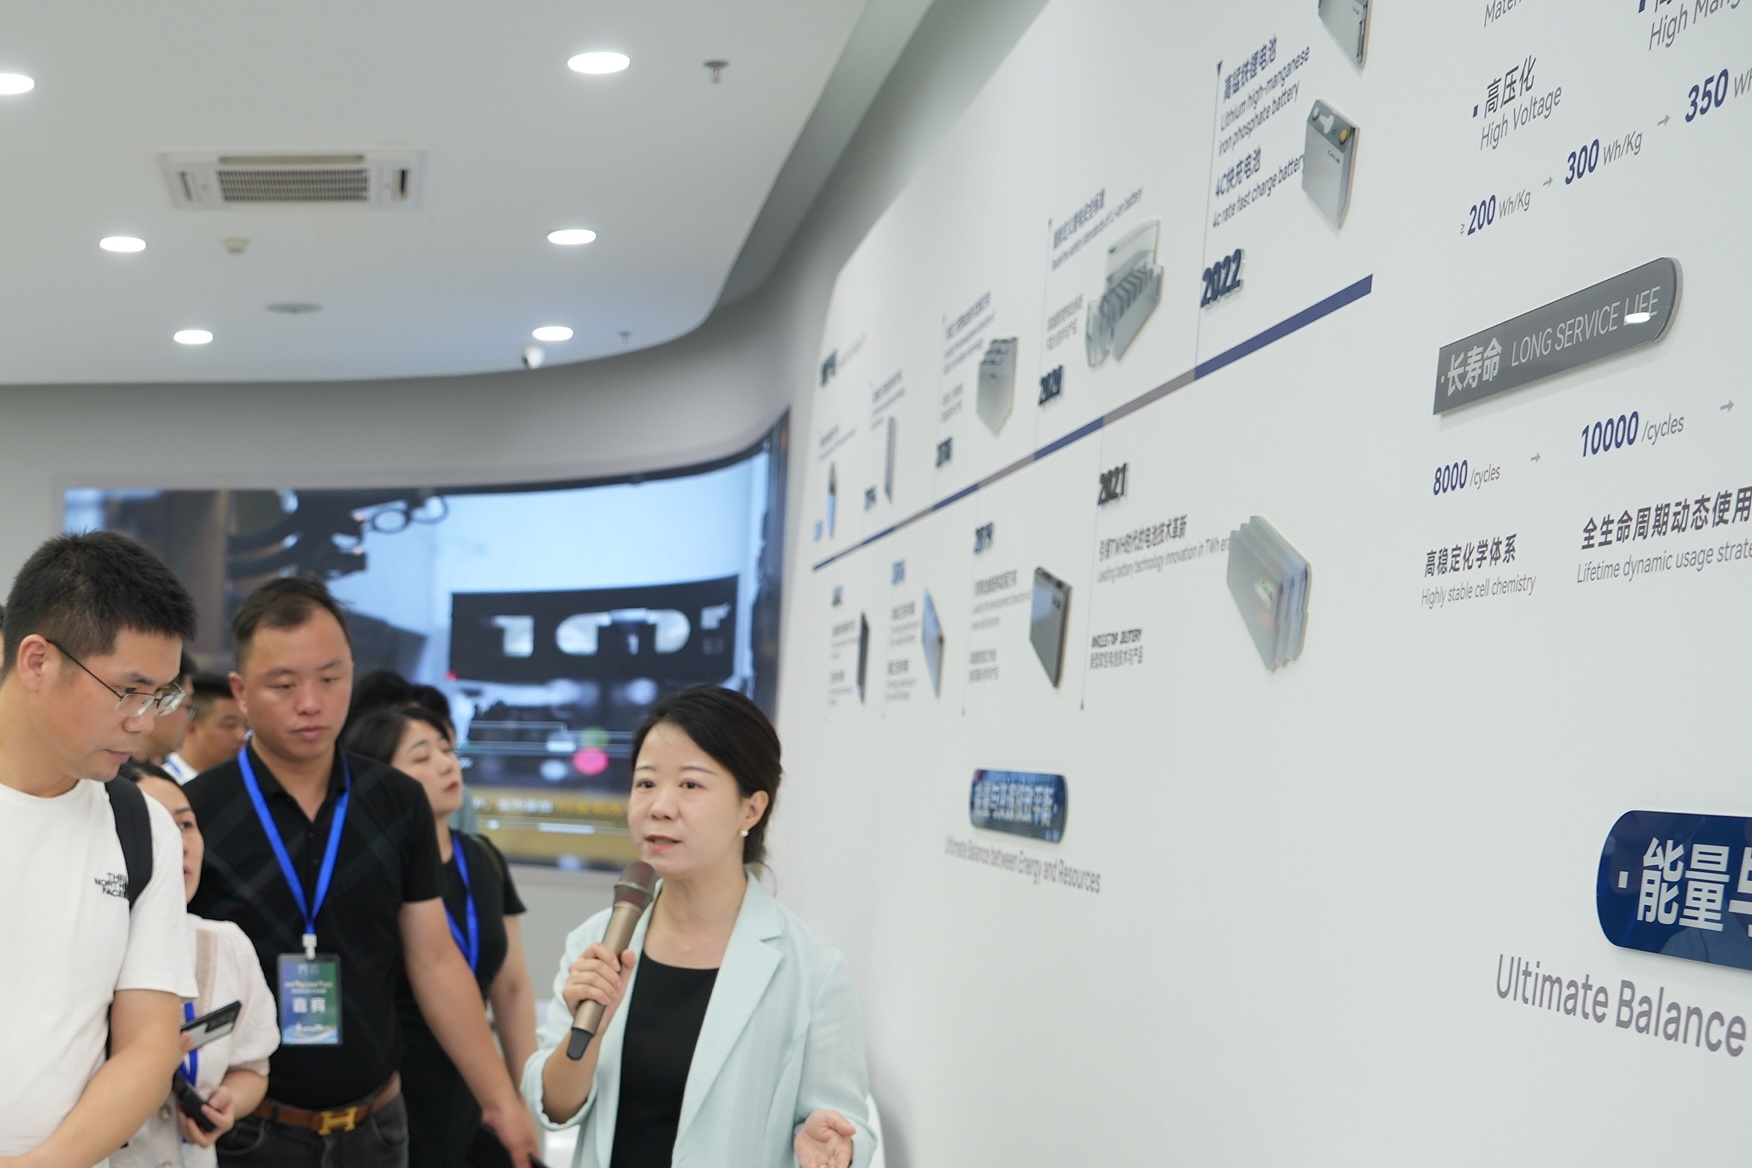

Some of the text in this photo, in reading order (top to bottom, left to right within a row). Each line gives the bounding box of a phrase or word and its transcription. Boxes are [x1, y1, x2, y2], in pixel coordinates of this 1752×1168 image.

[1648, 3, 1688, 51] High
[1220, 46, 1310, 132] Lithium high-manganese
[1232, 103, 1270, 151] phosphate
[1271, 80, 1300, 115] battery
[1483, 55, 1537, 119] 高压化
[1480, 86, 1562, 150] High Voltage
[1498, 189, 1531, 220] Wh/Kg
[1564, 138, 1599, 185] 300
[1603, 130, 1643, 166] Wh/Kg
[1684, 68, 1729, 122] 350
[1237, 190, 1251, 212] fast
[1251, 173, 1277, 202] charge
[1278, 154, 1305, 184] batter
[1200, 248, 1245, 309] 2022
[1511, 285, 1661, 368] LONG SERVICE LIFE
[1446, 337, 1502, 398] 长寿命
[1433, 410, 1685, 496] 8000 /cycles 10000 /cycles
[1097, 463, 1128, 507] 2021
[1581, 485, 1752, 550] 全生命周期动态使用
[1424, 533, 1517, 579] 高稳定化学体系
[1576, 560, 1620, 584] Lifetime
[1622, 550, 1673, 582] dynamic
[1675, 545, 1714, 573] usage
[1421, 572, 1537, 610] Highly stable cell chemistry
[107, 872, 128, 882] THE
[1018, 850, 1043, 885] Energy
[1043, 858, 1057, 883] and
[1058, 859, 1101, 895] Resources
[1496, 953, 1747, 1058] Ultimate Balance
